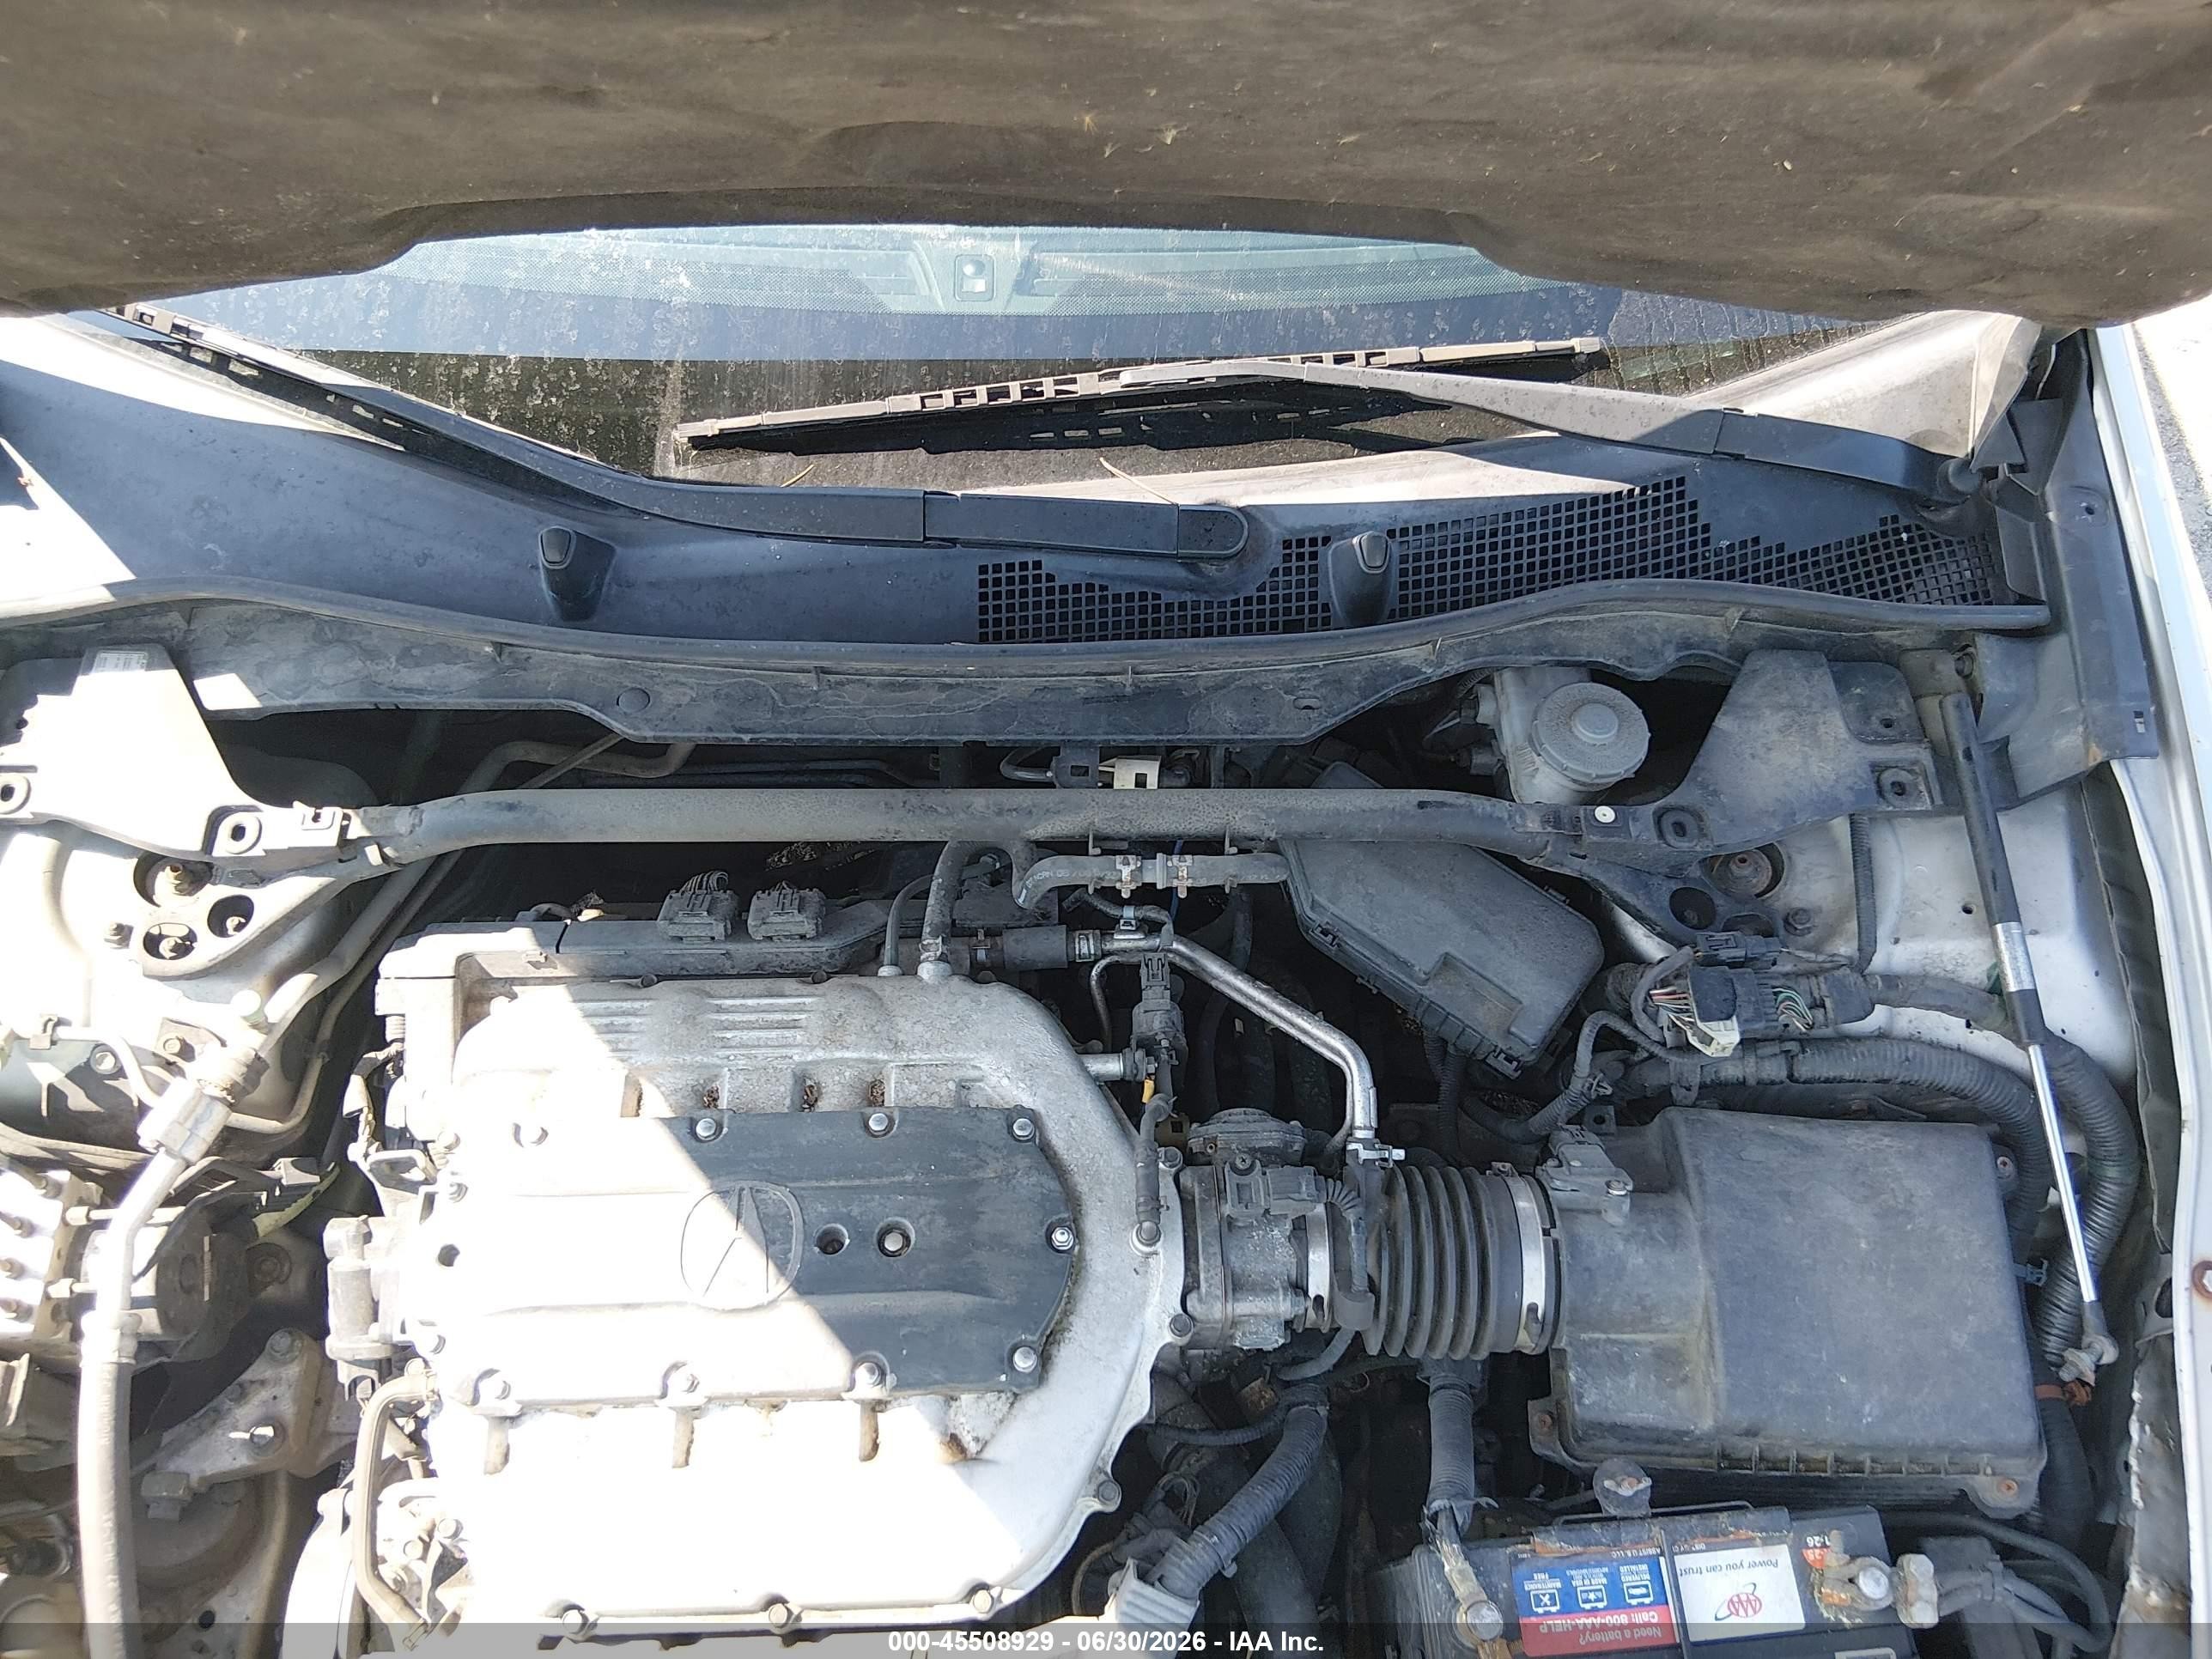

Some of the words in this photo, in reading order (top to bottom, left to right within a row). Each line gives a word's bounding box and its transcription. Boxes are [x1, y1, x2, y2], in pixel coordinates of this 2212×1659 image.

[1679, 1564, 1703, 1577] trust
[1705, 1565, 1723, 1573] can
[1726, 1560, 1745, 1571] you
[1747, 1559, 1778, 1570] Power
[1730, 1593, 1761, 1617] AAA
[1539, 1613, 1629, 1633] 800-AAA-HELP
[1630, 1611, 1659, 1623] Call:
[1579, 1630, 1622, 1645] battery?
[1634, 1626, 1662, 1638] Need
